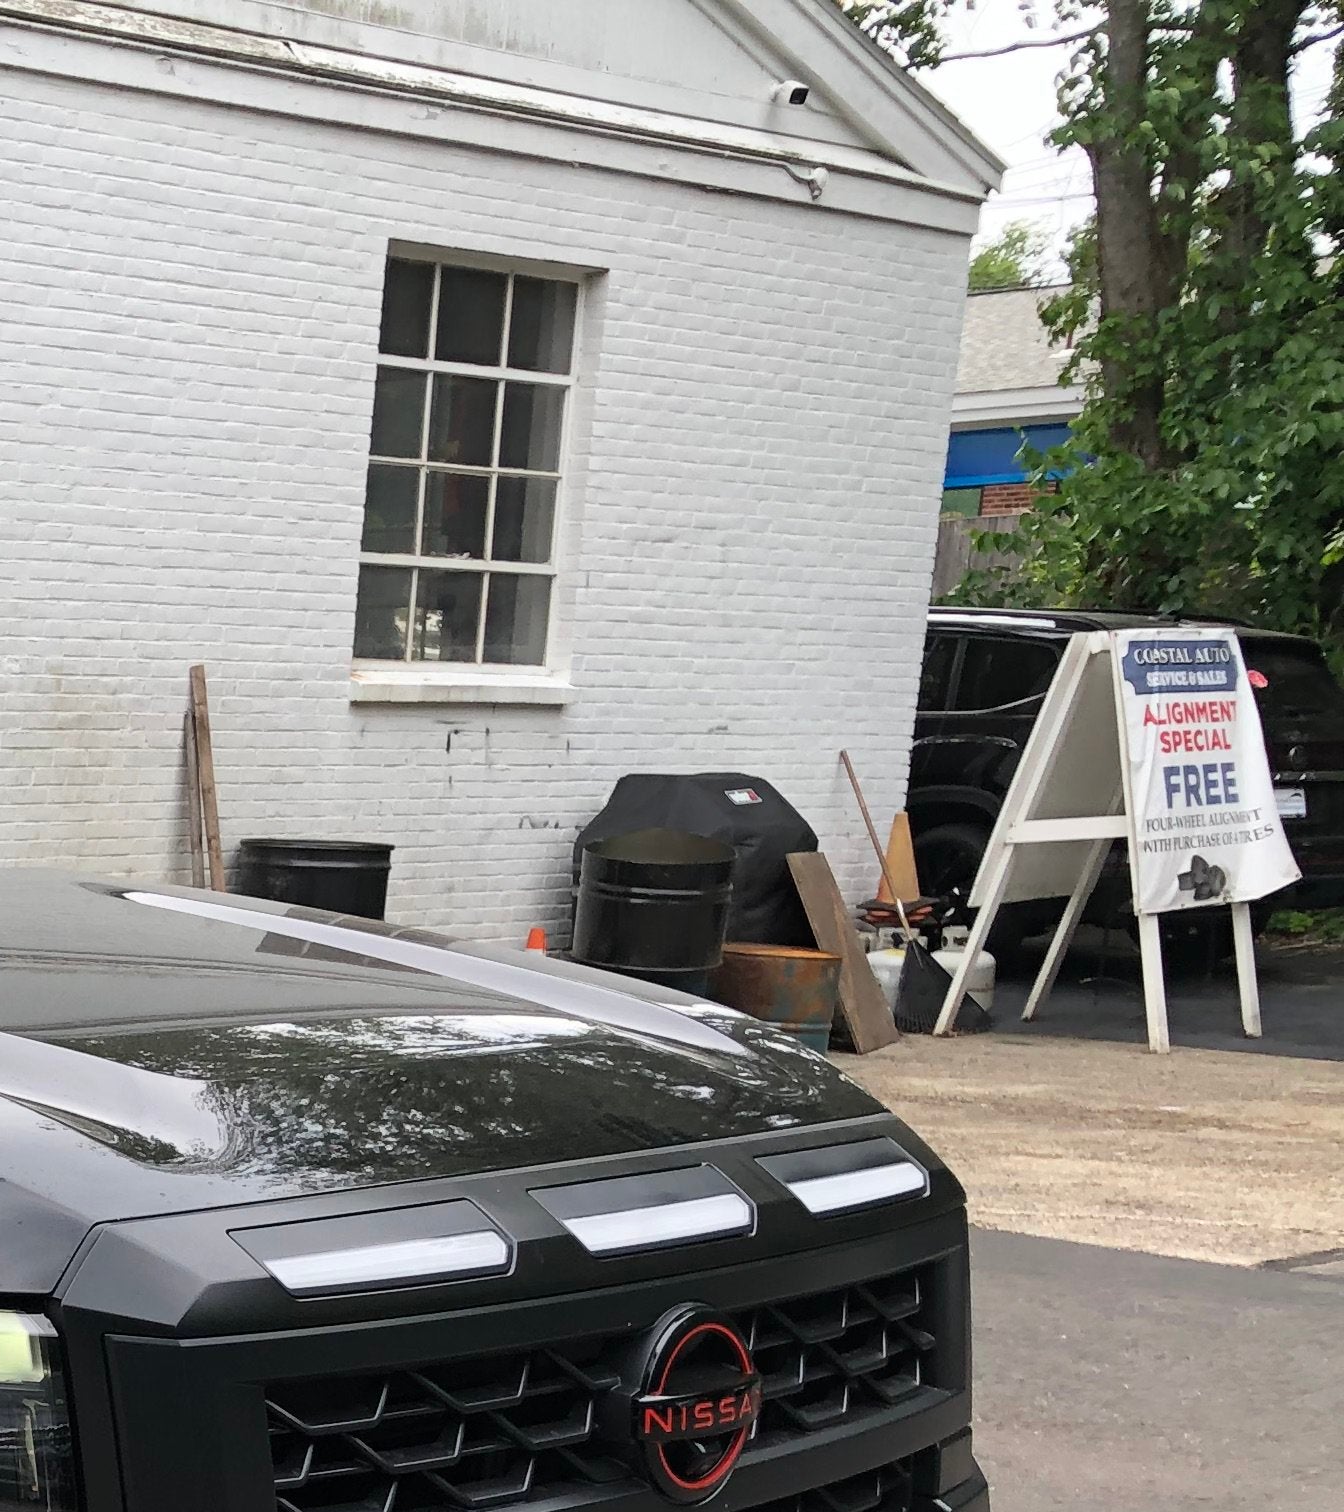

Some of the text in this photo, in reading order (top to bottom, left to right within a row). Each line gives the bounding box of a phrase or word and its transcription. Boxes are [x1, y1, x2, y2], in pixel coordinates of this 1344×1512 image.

[1133, 647, 1230, 665] COASTAL AUTO
[1146, 670, 1189, 688] SERVICE
[1197, 669, 1228, 686] SALES
[1143, 700, 1237, 726] ALIGNMENT
[1160, 728, 1232, 753] SPECIAL
[1163, 762, 1240, 809] FREE
[1146, 814, 1207, 832] FOUR-WHEEL
[1173, 832, 1221, 851] PURCHASE
[643, 1392, 755, 1434] NISSA
